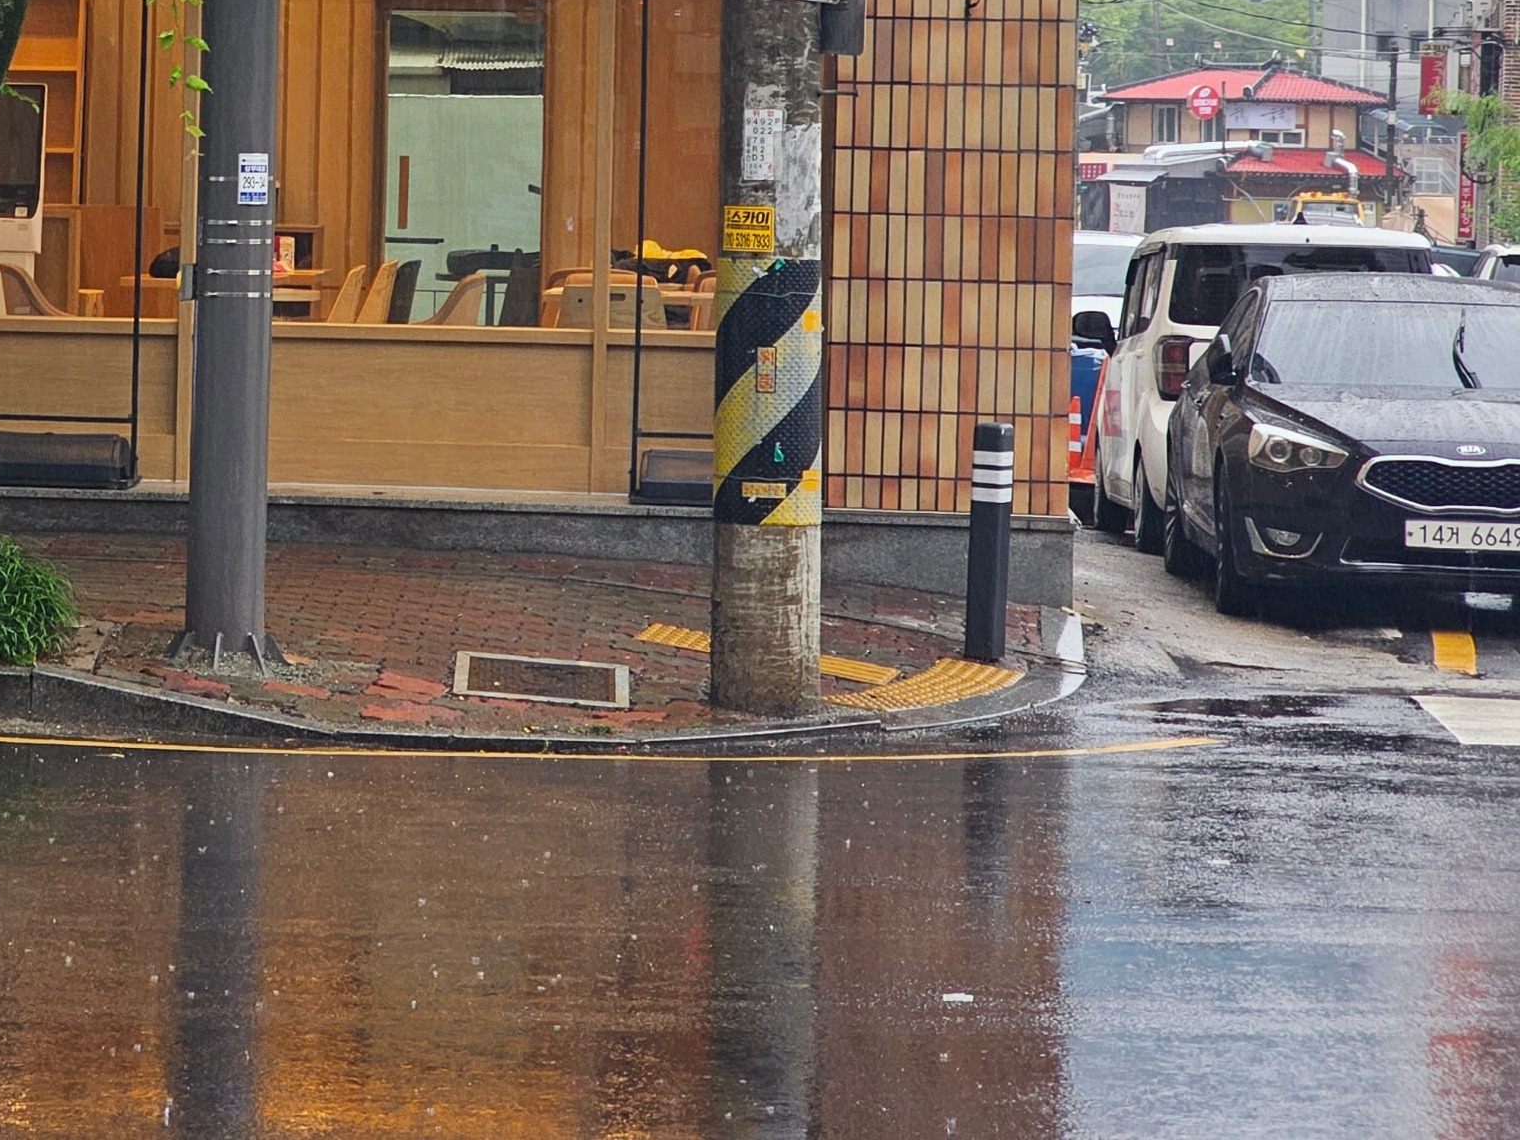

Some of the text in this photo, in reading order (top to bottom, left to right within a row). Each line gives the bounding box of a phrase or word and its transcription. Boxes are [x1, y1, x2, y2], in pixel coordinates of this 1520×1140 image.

[731, 211, 771, 225] 스카이
[1459, 445, 1482, 453] KIA
[1419, 525, 1460, 545] 14거
